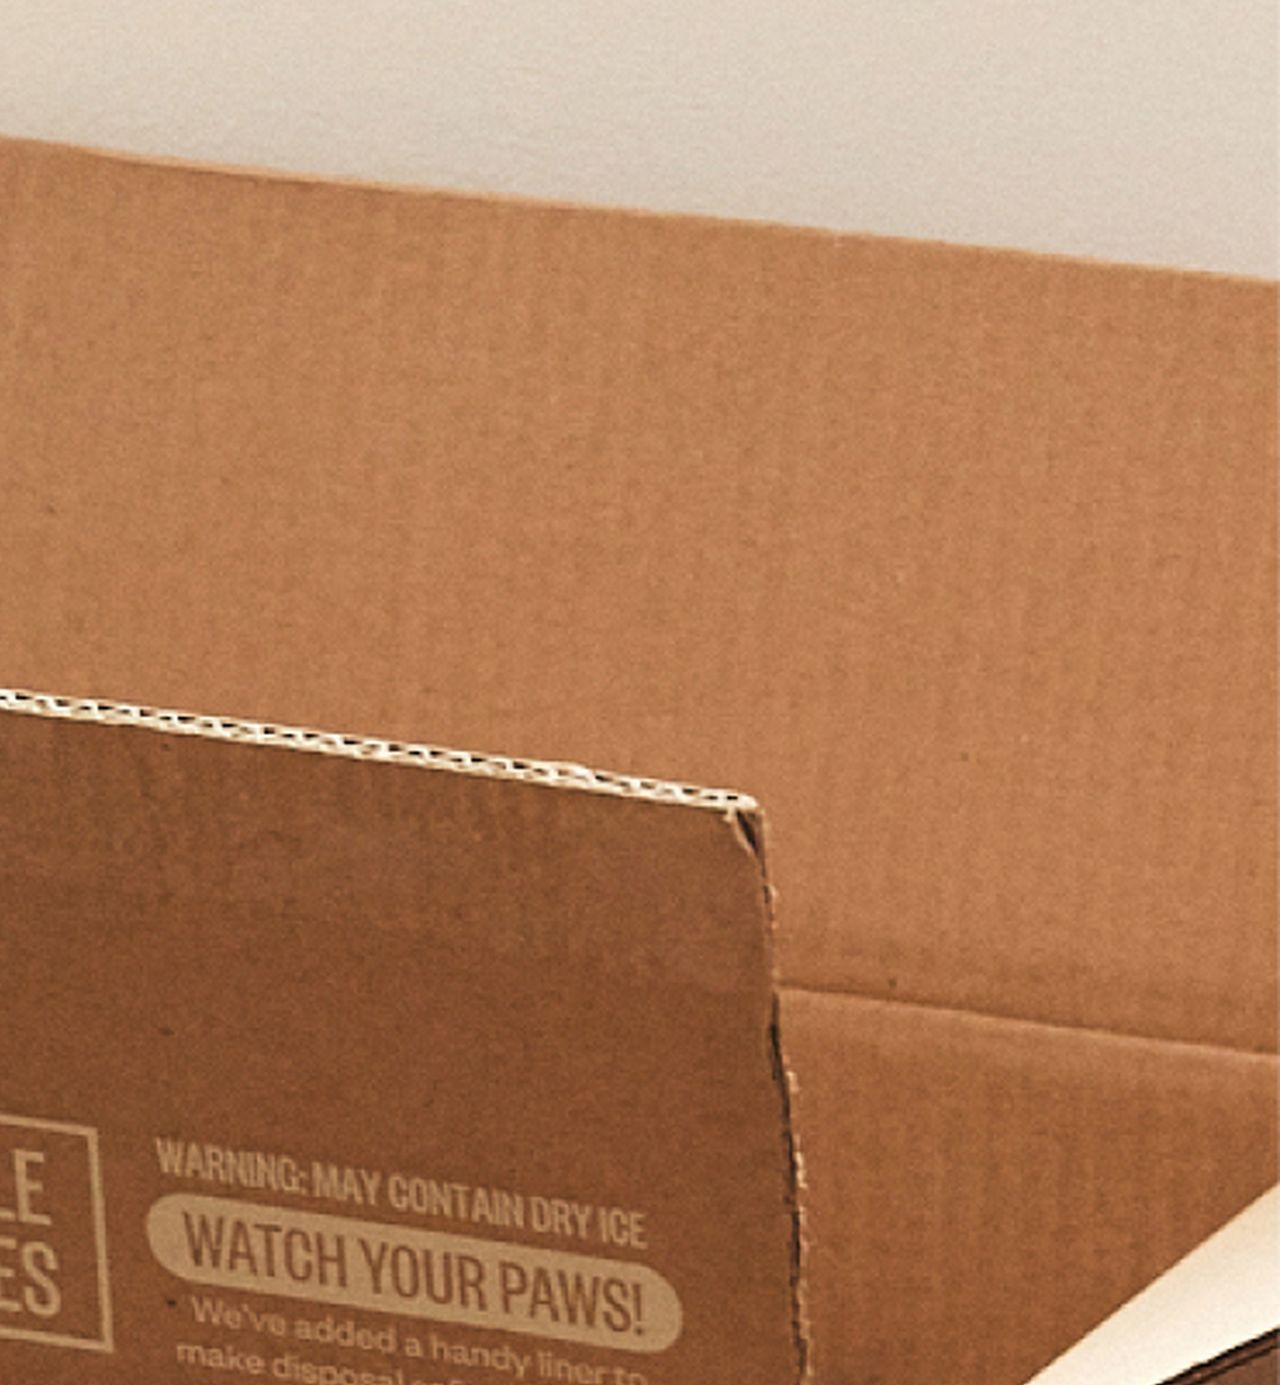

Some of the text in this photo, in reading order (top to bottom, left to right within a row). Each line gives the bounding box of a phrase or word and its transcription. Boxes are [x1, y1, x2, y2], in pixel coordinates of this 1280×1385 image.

[153, 1136, 649, 1250] WARNING: MAY CONTAIN DRY ICE
[182, 1210, 646, 1336] WATCH YOUR PAWS!
[176, 1342, 267, 1376] make
[190, 1296, 286, 1336] We've
[293, 1311, 397, 1355] added
[405, 1335, 425, 1359] a
[431, 1331, 533, 1378] handy
